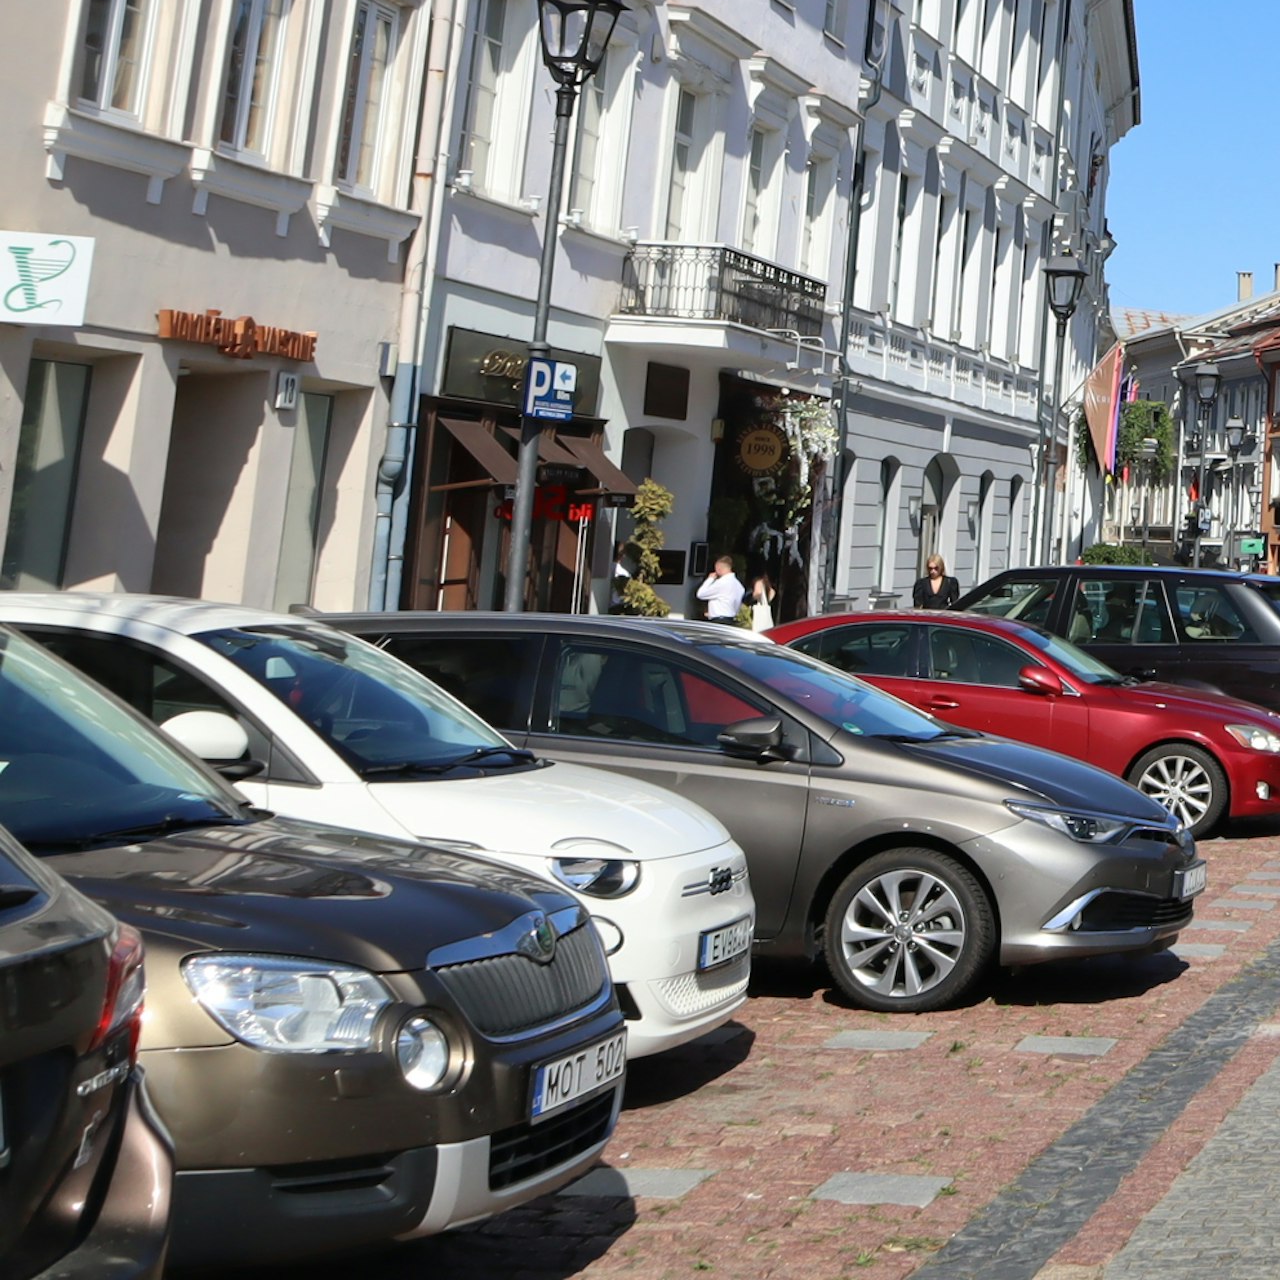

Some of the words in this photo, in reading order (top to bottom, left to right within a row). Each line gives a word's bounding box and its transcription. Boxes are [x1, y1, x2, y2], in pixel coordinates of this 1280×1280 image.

[284, 377, 296, 404] 13
[526, 361, 552, 414] P
[747, 443, 776, 456] 1998
[544, 1053, 587, 1107] MOT
[595, 1036, 624, 1082] 502
